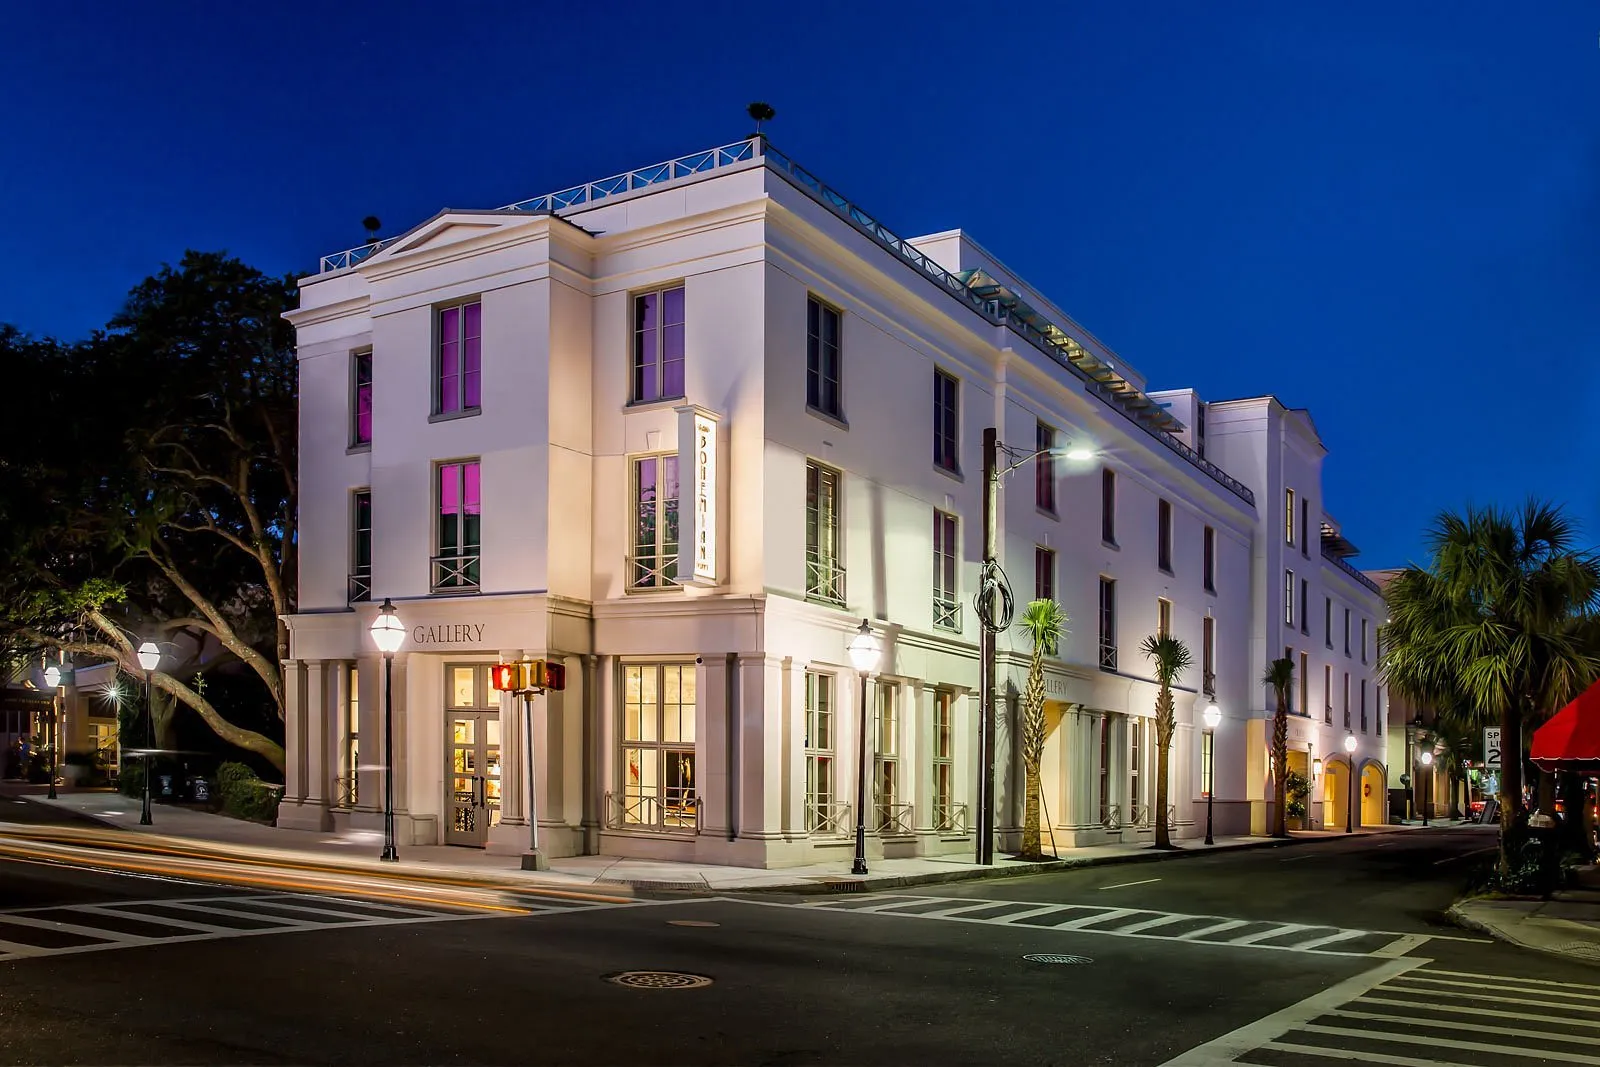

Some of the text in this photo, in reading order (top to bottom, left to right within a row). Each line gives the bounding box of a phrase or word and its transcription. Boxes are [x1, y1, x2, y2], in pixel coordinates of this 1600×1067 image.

[699, 435, 707, 560] BOHEMIAN
[413, 623, 485, 643] GALLERY
[1046, 679, 1068, 695] LLERY
[1487, 749, 1501, 764] 2
